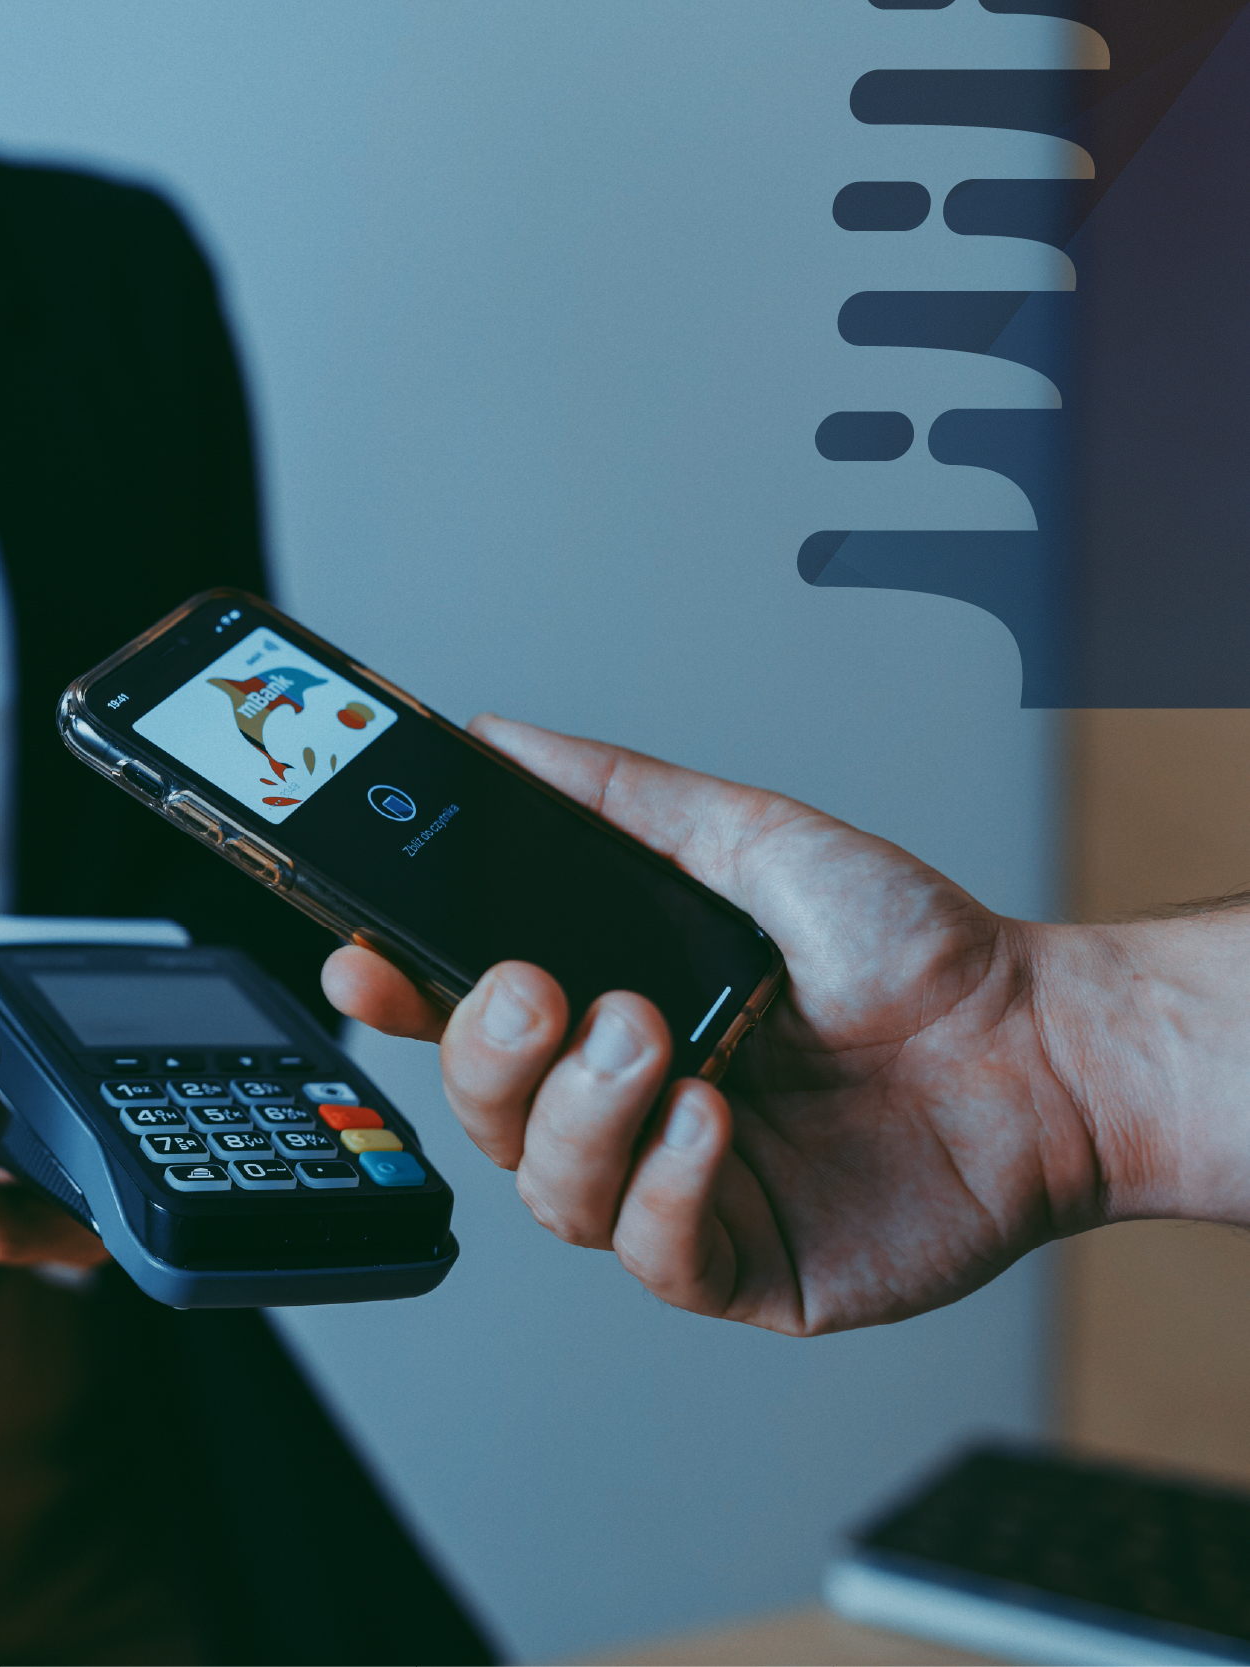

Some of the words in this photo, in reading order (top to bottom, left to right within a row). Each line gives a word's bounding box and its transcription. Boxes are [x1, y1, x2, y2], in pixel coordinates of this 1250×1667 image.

[107, 693, 129, 709] 19:41
[237, 674, 294, 719] mBank
[420, 830, 434, 840] do
[117, 1084, 134, 1097] 1
[181, 1082, 204, 1096] 2
[244, 1082, 265, 1096] 3
[138, 1109, 157, 1122] 4
[203, 1108, 225, 1121] 5
[264, 1107, 285, 1120] 6
[153, 1136, 171, 1151] 7
[223, 1135, 245, 1148] 8
[285, 1133, 307, 1147] 9
[243, 1163, 266, 1177] 0
